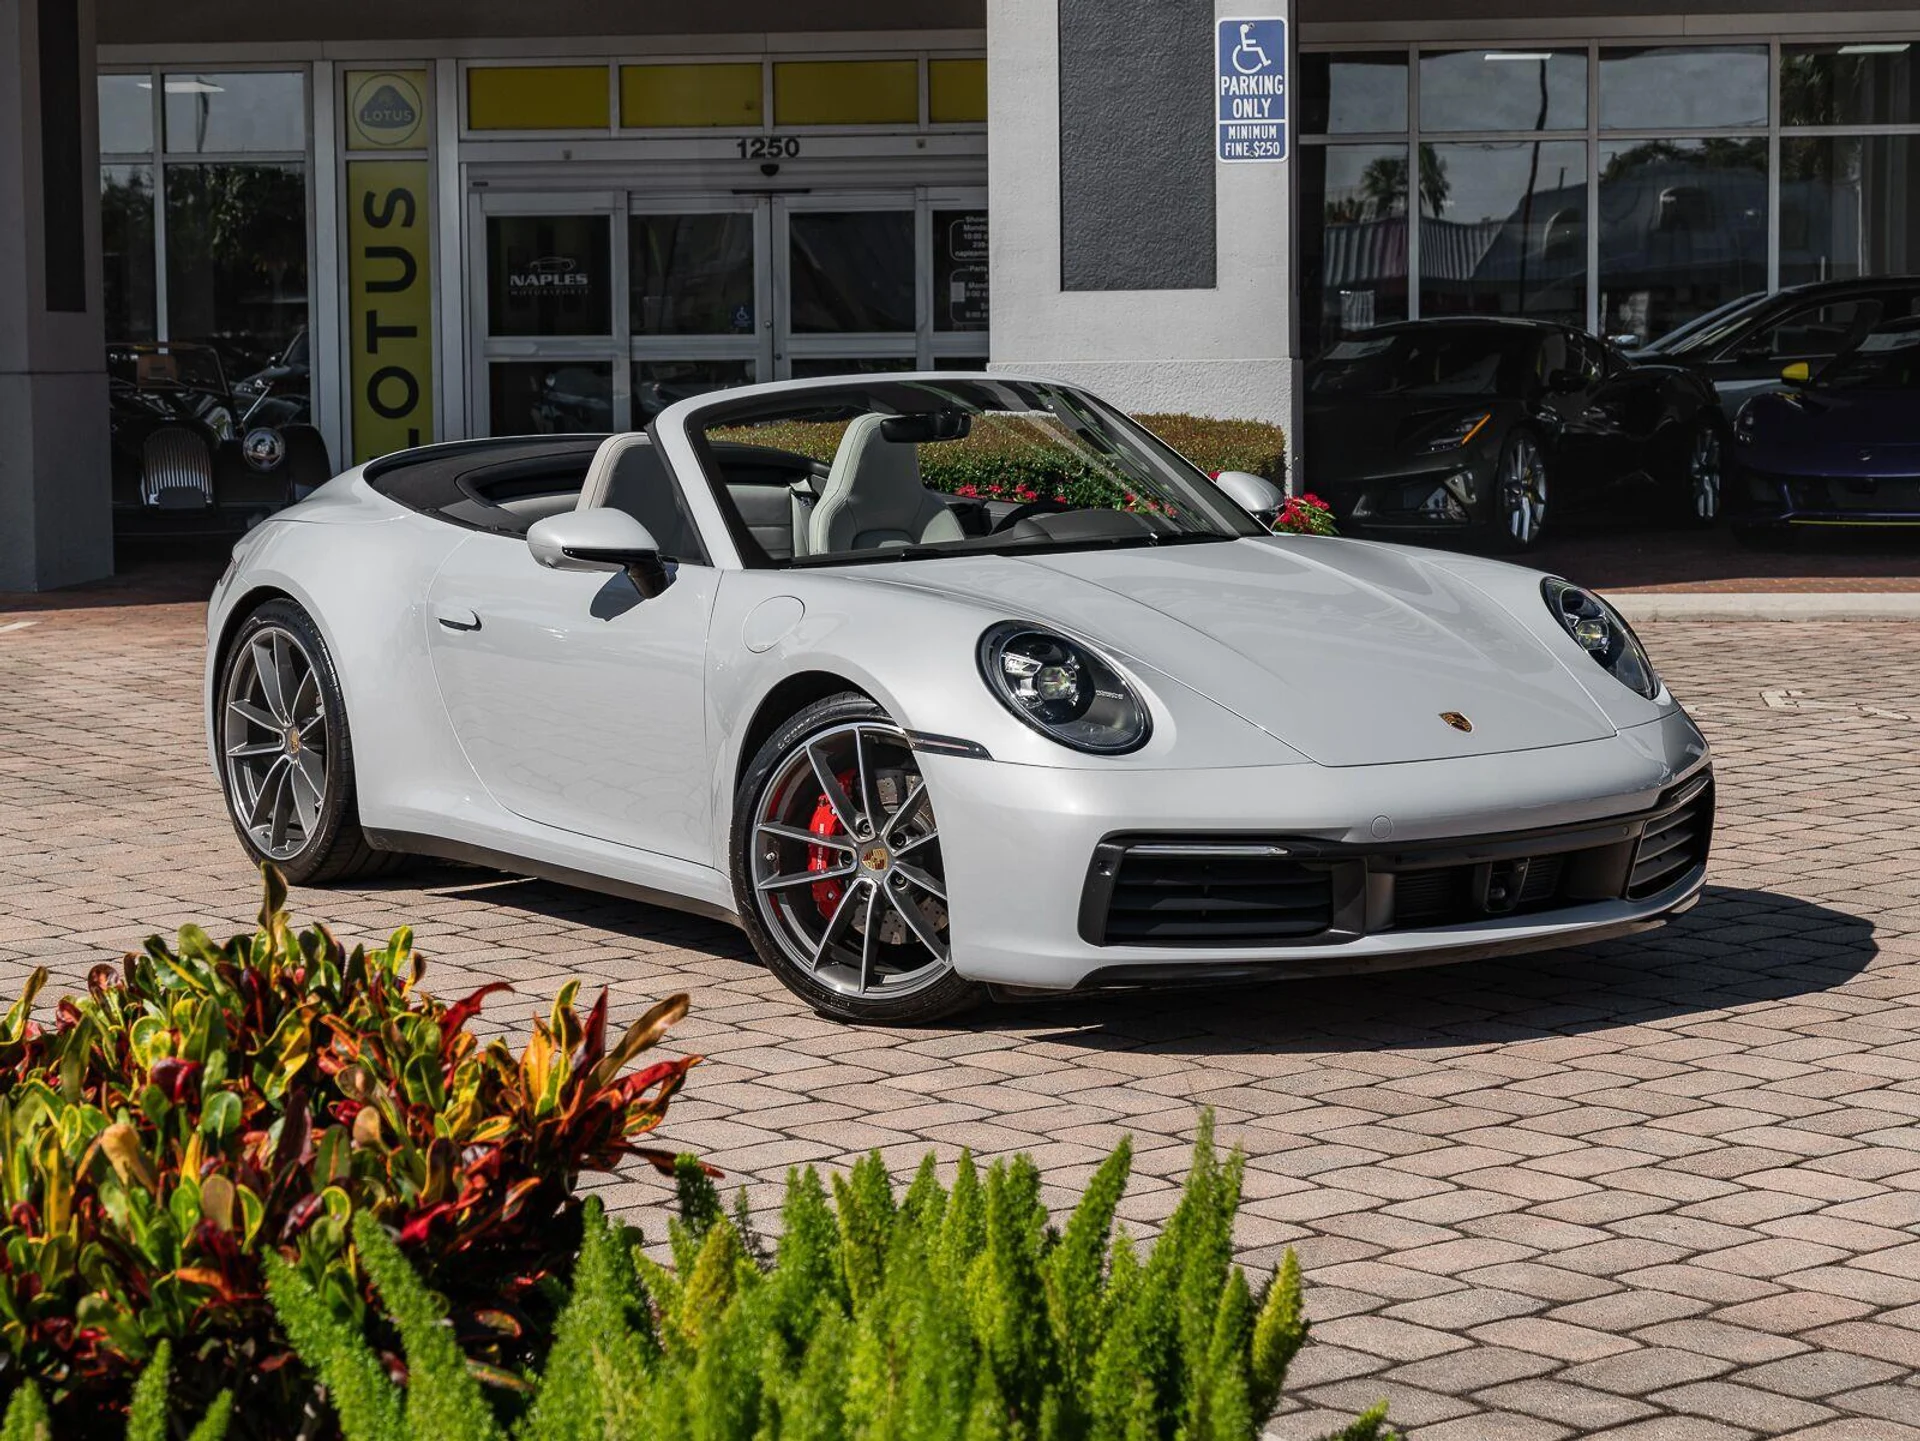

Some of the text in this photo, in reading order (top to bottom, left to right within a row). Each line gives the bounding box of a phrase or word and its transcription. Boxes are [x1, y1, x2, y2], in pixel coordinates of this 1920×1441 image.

[1221, 75, 1284, 96] PARKING
[363, 109, 413, 122] LOTUS
[1232, 98, 1272, 119] ONLY
[1228, 125, 1277, 140] MINIMUM
[736, 136, 800, 159] 1250
[1225, 141, 1281, 158] FINE $250
[509, 272, 589, 287] NAPLES
